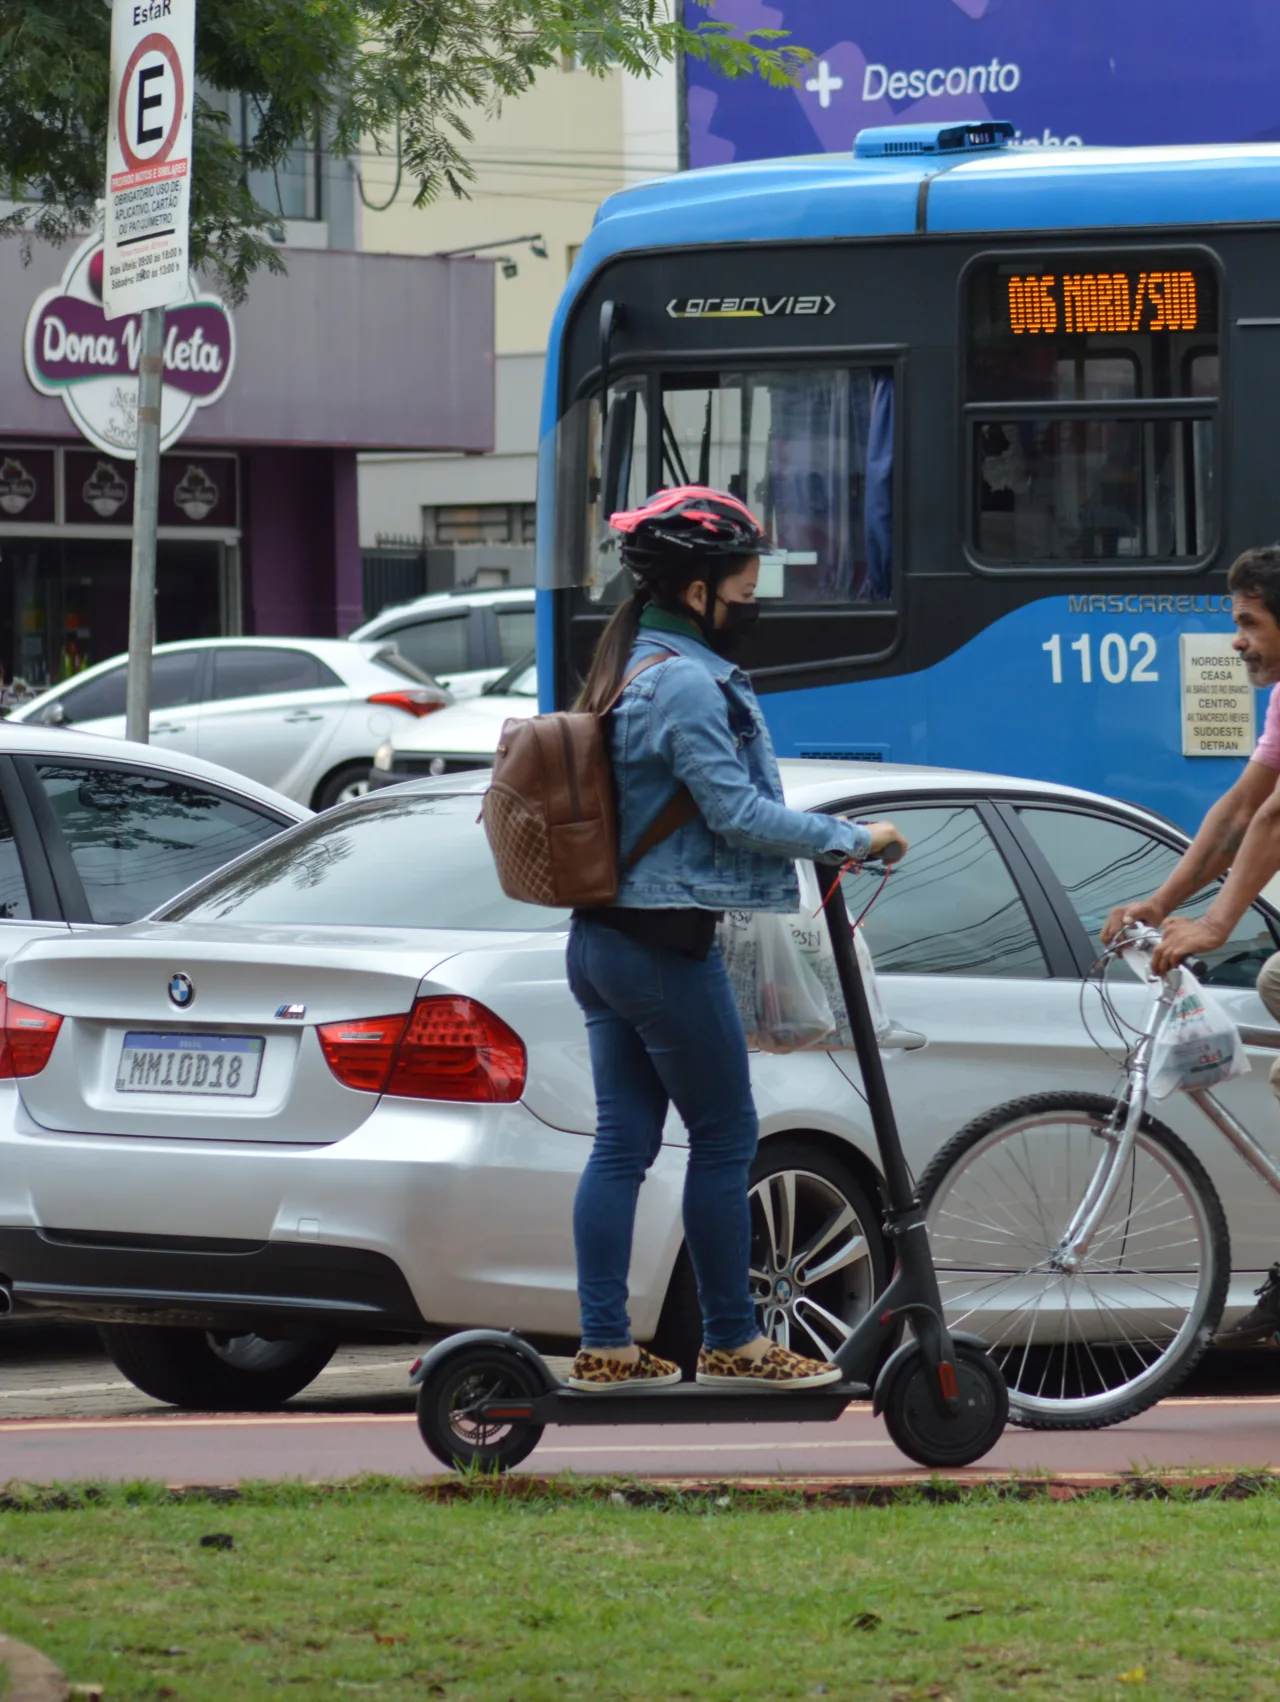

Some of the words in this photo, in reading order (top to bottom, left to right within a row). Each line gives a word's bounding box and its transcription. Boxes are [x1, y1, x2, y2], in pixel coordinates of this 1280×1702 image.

[862, 57, 1020, 101] Desconto
[137, 64, 164, 145] E
[156, 182, 169, 197] USO
[171, 180, 180, 193] DE
[43, 316, 118, 366] Dona
[122, 317, 222, 373] Vleta
[1042, 632, 1159, 684] 1102
[1191, 656, 1242, 667] NORDESTE
[1200, 671, 1233, 681] CEASA
[1198, 698, 1237, 709] CENTRO
[1193, 726, 1244, 737] SUDOESTE
[1200, 740, 1239, 751] DETRAN
